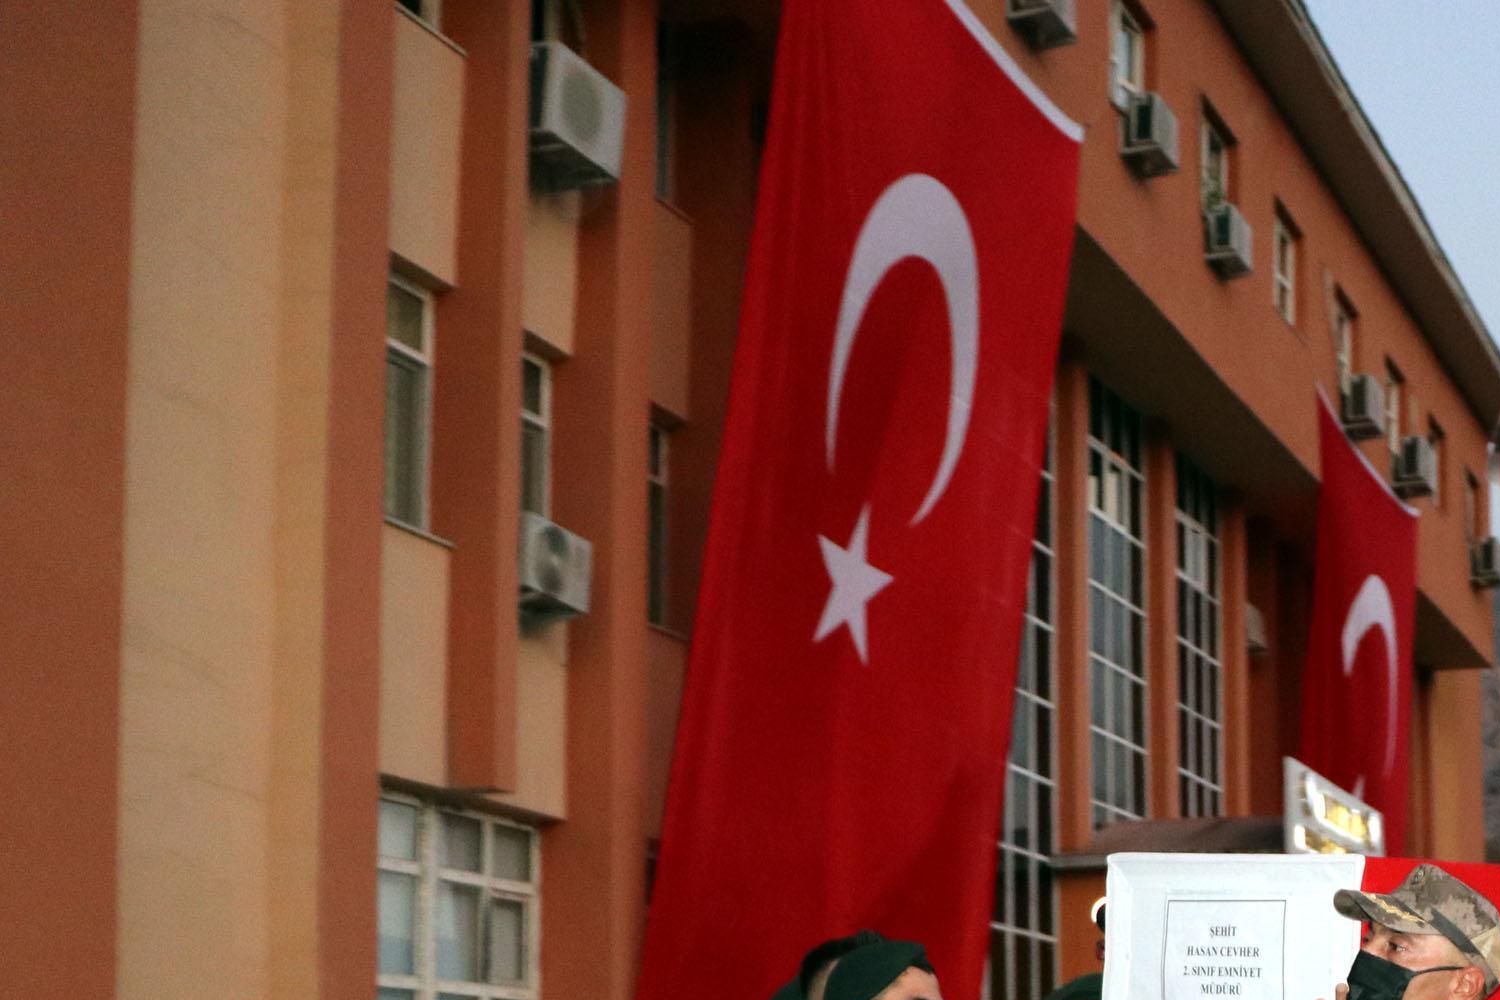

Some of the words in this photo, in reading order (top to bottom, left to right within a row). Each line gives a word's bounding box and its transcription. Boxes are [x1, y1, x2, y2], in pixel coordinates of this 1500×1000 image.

[1209, 924, 1237, 938] ŞEHİT
[1187, 945, 1218, 957] HASAN
[1220, 946, 1260, 957] CEVHER
[1183, 965, 1190, 976] 2.
[1191, 966, 1216, 976] SINIF
[1218, 965, 1262, 978] EMNİYET
[1201, 981, 1242, 995] MÜDÜRÜ
